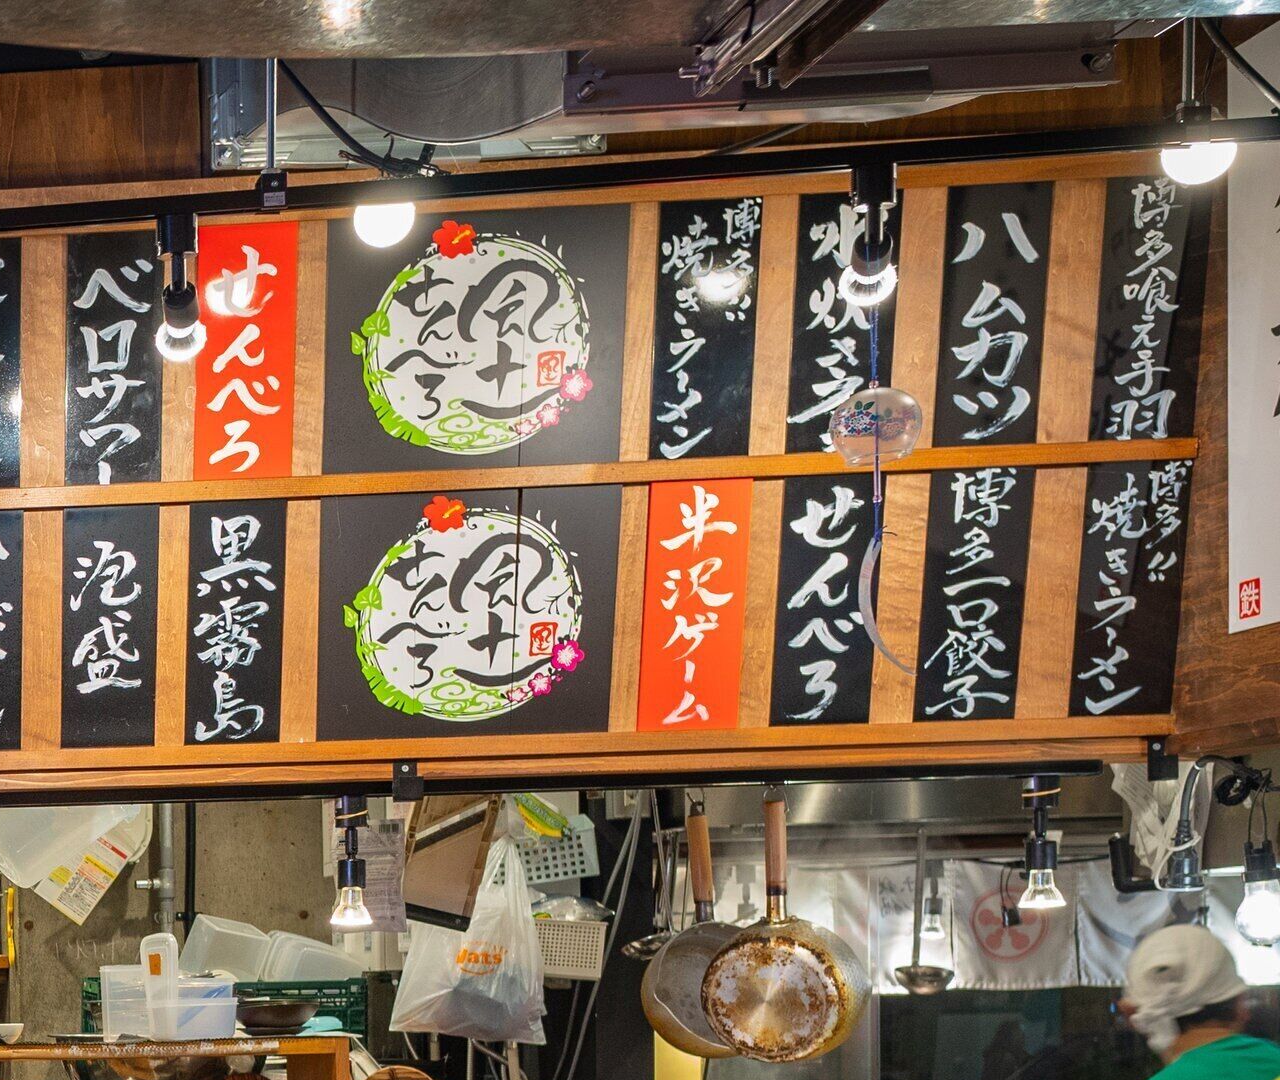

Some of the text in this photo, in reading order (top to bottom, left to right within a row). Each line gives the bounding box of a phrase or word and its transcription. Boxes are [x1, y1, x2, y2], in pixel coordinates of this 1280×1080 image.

[72, 259, 153, 486] ベロサワー
[203, 245, 281, 472] せんべろ
[659, 215, 719, 460] 焼きラーメン
[952, 212, 1038, 440] ハムカツ
[70, 540, 142, 695] 泡盛
[194, 514, 276, 742] 黒霧島
[659, 485, 738, 726] 半沢ゲーム
[786, 487, 865, 720] せんべろ
[924, 467, 1018, 719] 博多一口餃子
[1077, 473, 1150, 716] 焼きラーメン
